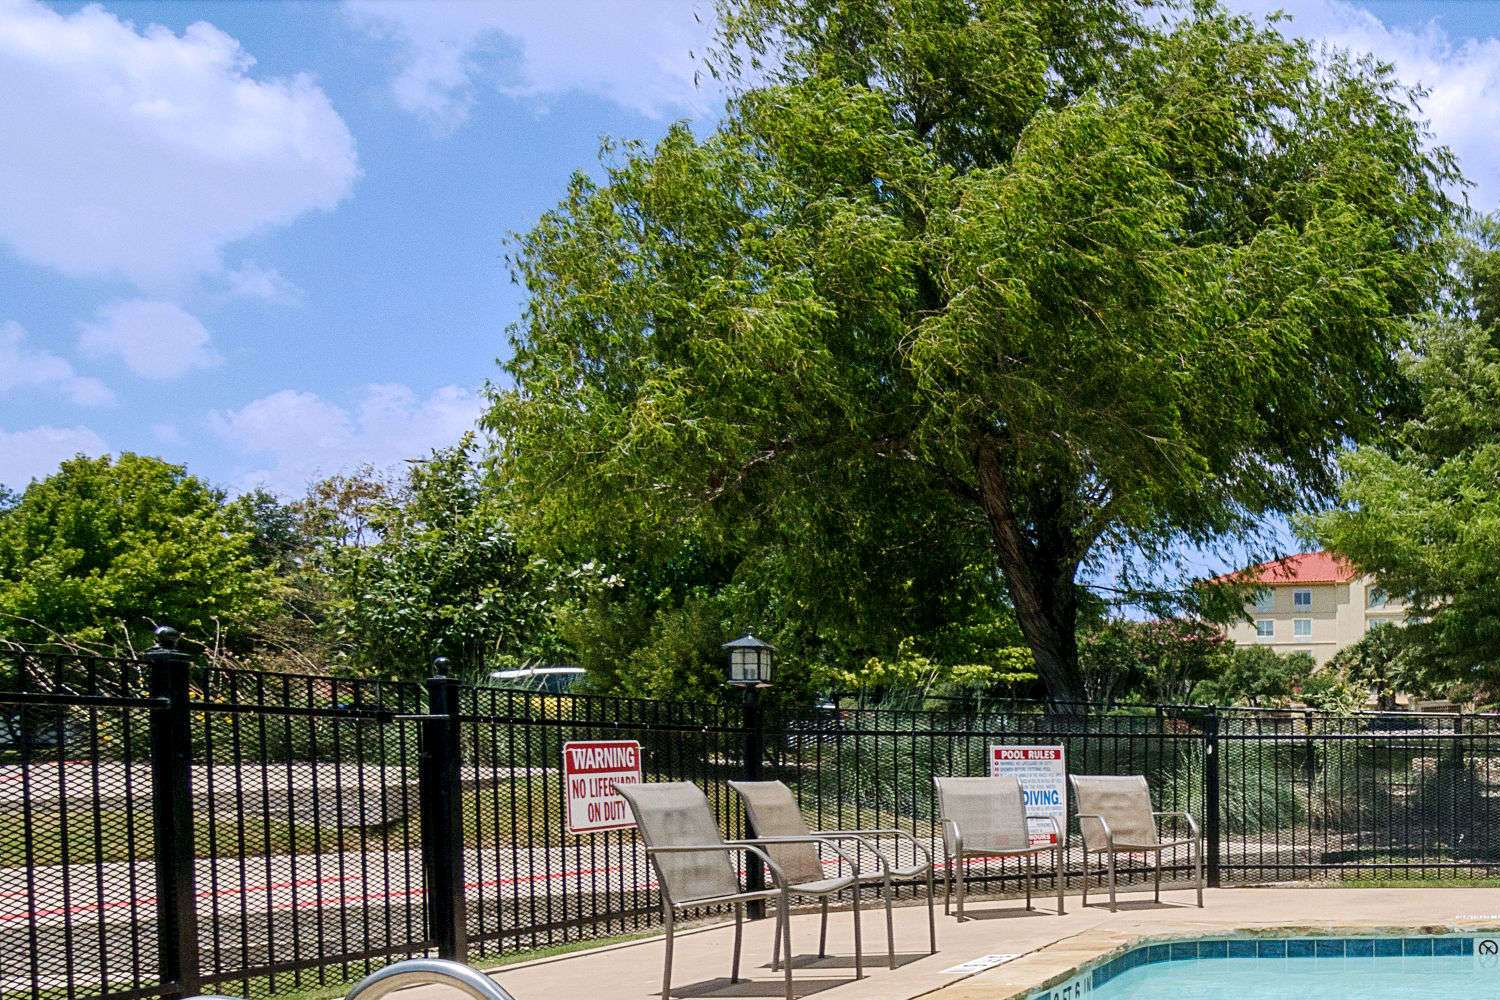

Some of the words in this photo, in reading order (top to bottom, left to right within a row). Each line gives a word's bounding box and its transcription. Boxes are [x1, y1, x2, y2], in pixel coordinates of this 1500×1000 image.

[572, 747, 635, 770] WARNING
[1001, 750, 1025, 759] POOL
[1028, 750, 1055, 759] RULES
[572, 779, 586, 799] NO
[589, 776, 636, 798] LIFEG
[587, 802, 602, 823] ON
[604, 800, 626, 821] DUTY
